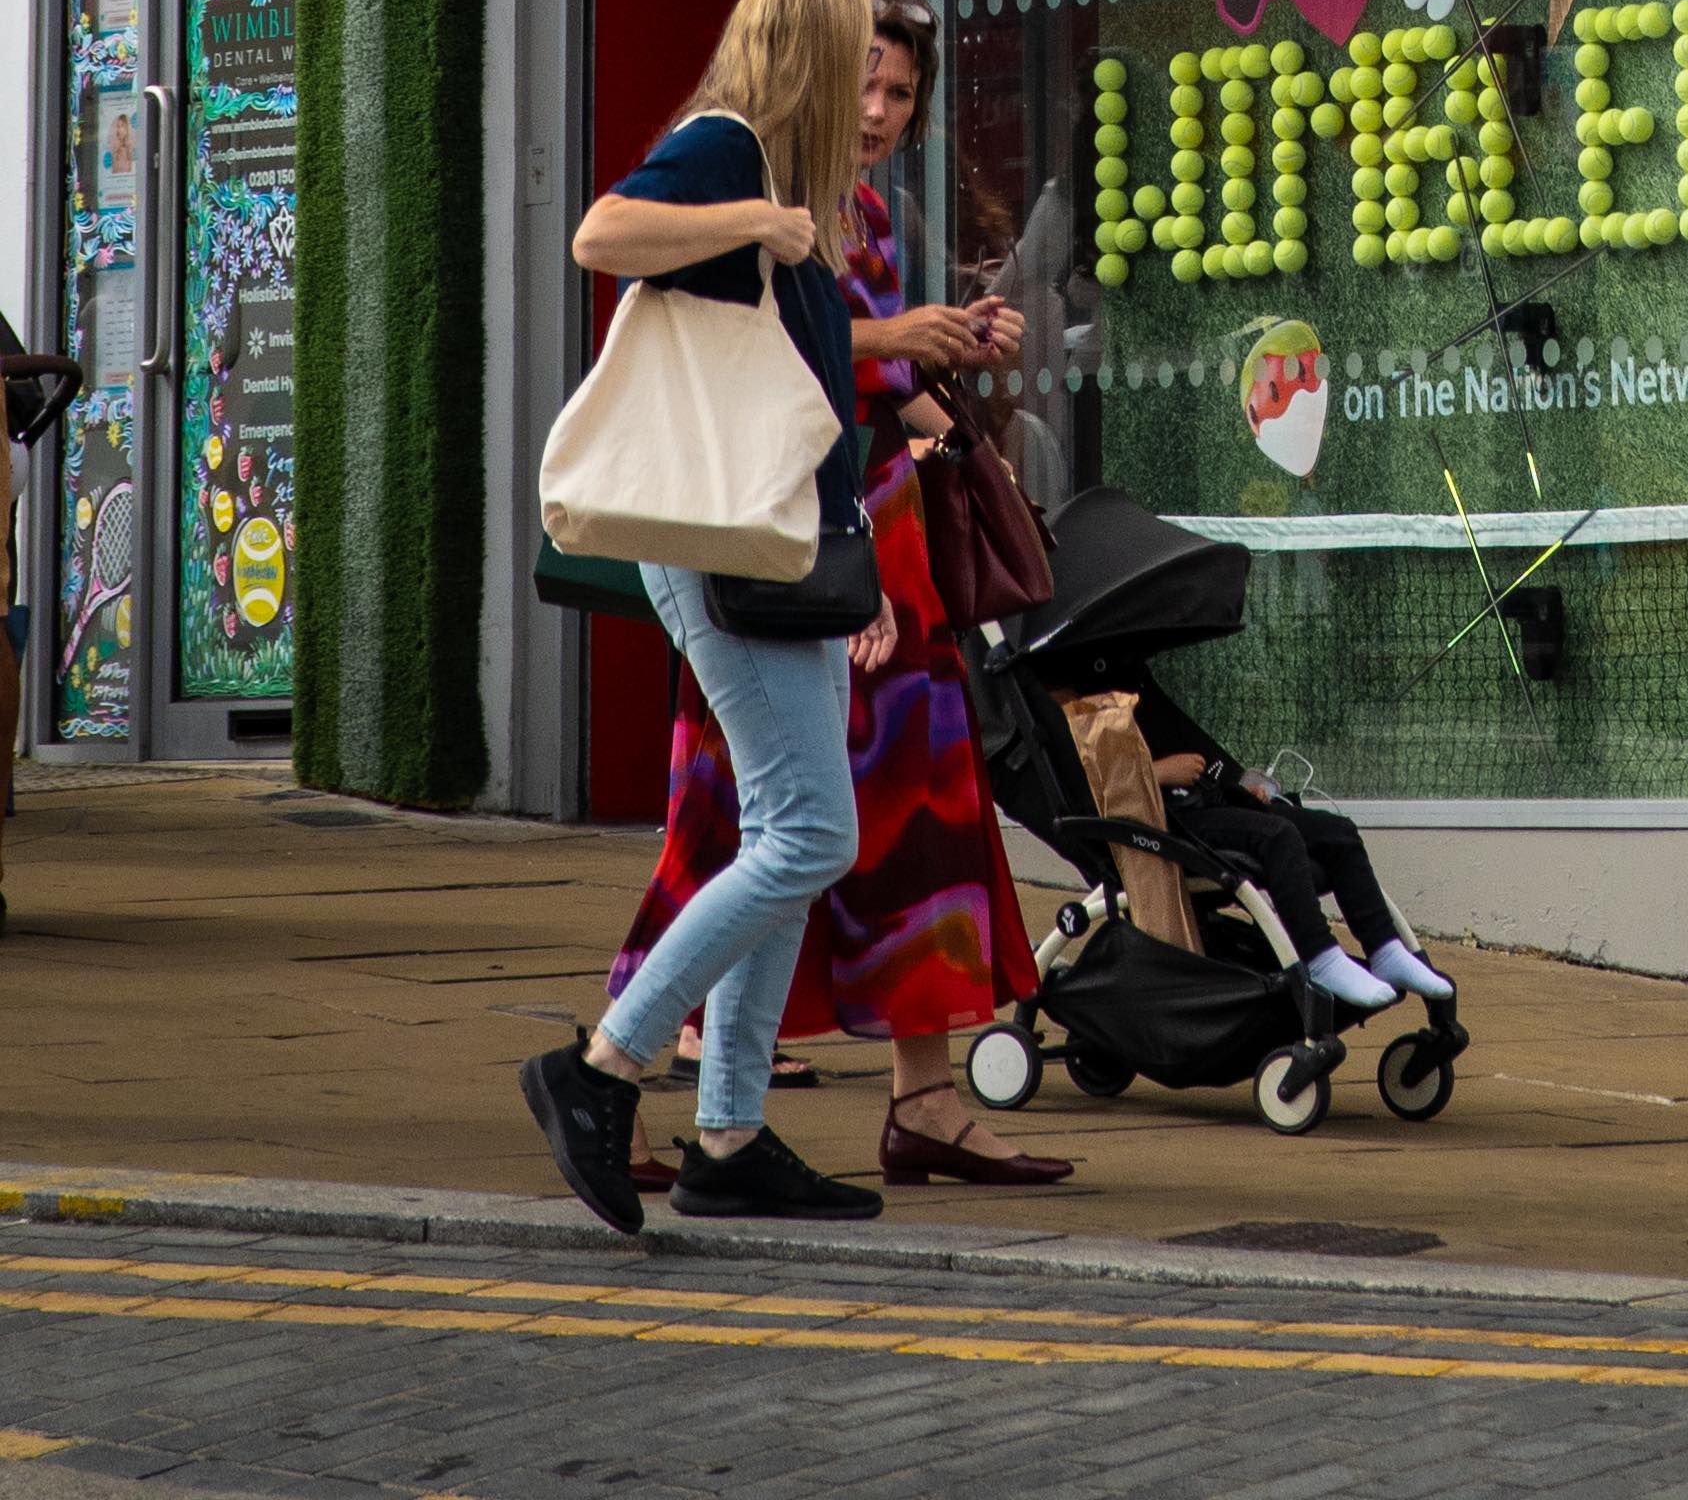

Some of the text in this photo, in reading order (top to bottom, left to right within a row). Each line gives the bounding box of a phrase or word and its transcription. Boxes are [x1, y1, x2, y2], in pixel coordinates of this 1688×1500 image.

[211, 7, 294, 43] WIMBL
[213, 48, 274, 68] DENTAL
[249, 169, 275, 188] 0208
[239, 286, 280, 304] Holistic
[242, 375, 280, 394] Dental
[1343, 384, 1385, 421] on
[1391, 369, 1456, 418] The
